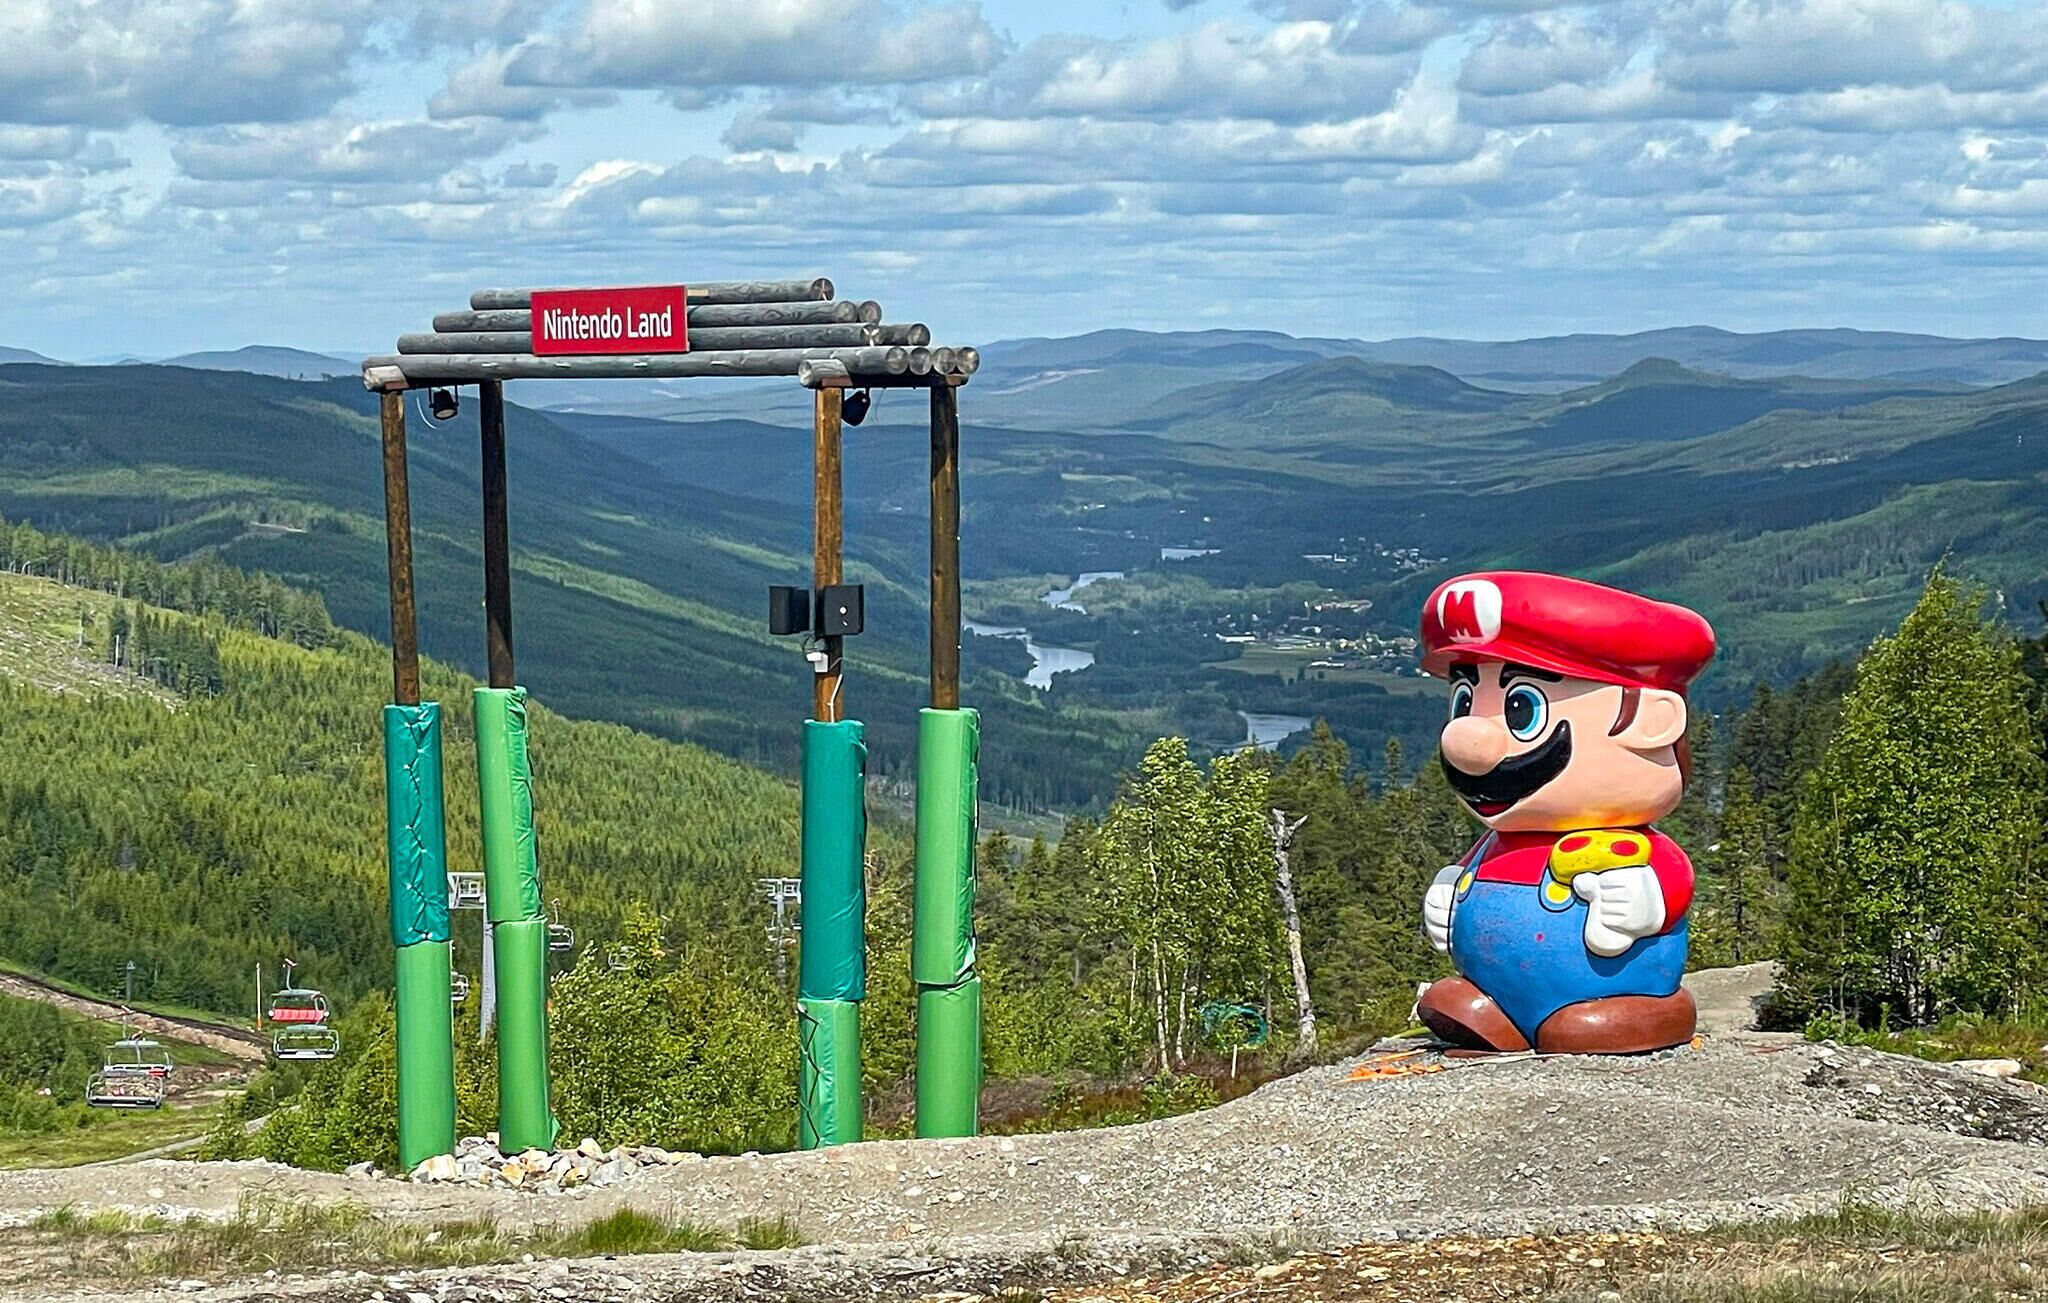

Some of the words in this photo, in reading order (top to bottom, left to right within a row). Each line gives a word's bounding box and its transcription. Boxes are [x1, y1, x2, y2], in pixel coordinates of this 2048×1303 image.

[543, 307, 622, 340] Nintendo
[627, 304, 672, 338] Land
[1443, 590, 1483, 637] M
